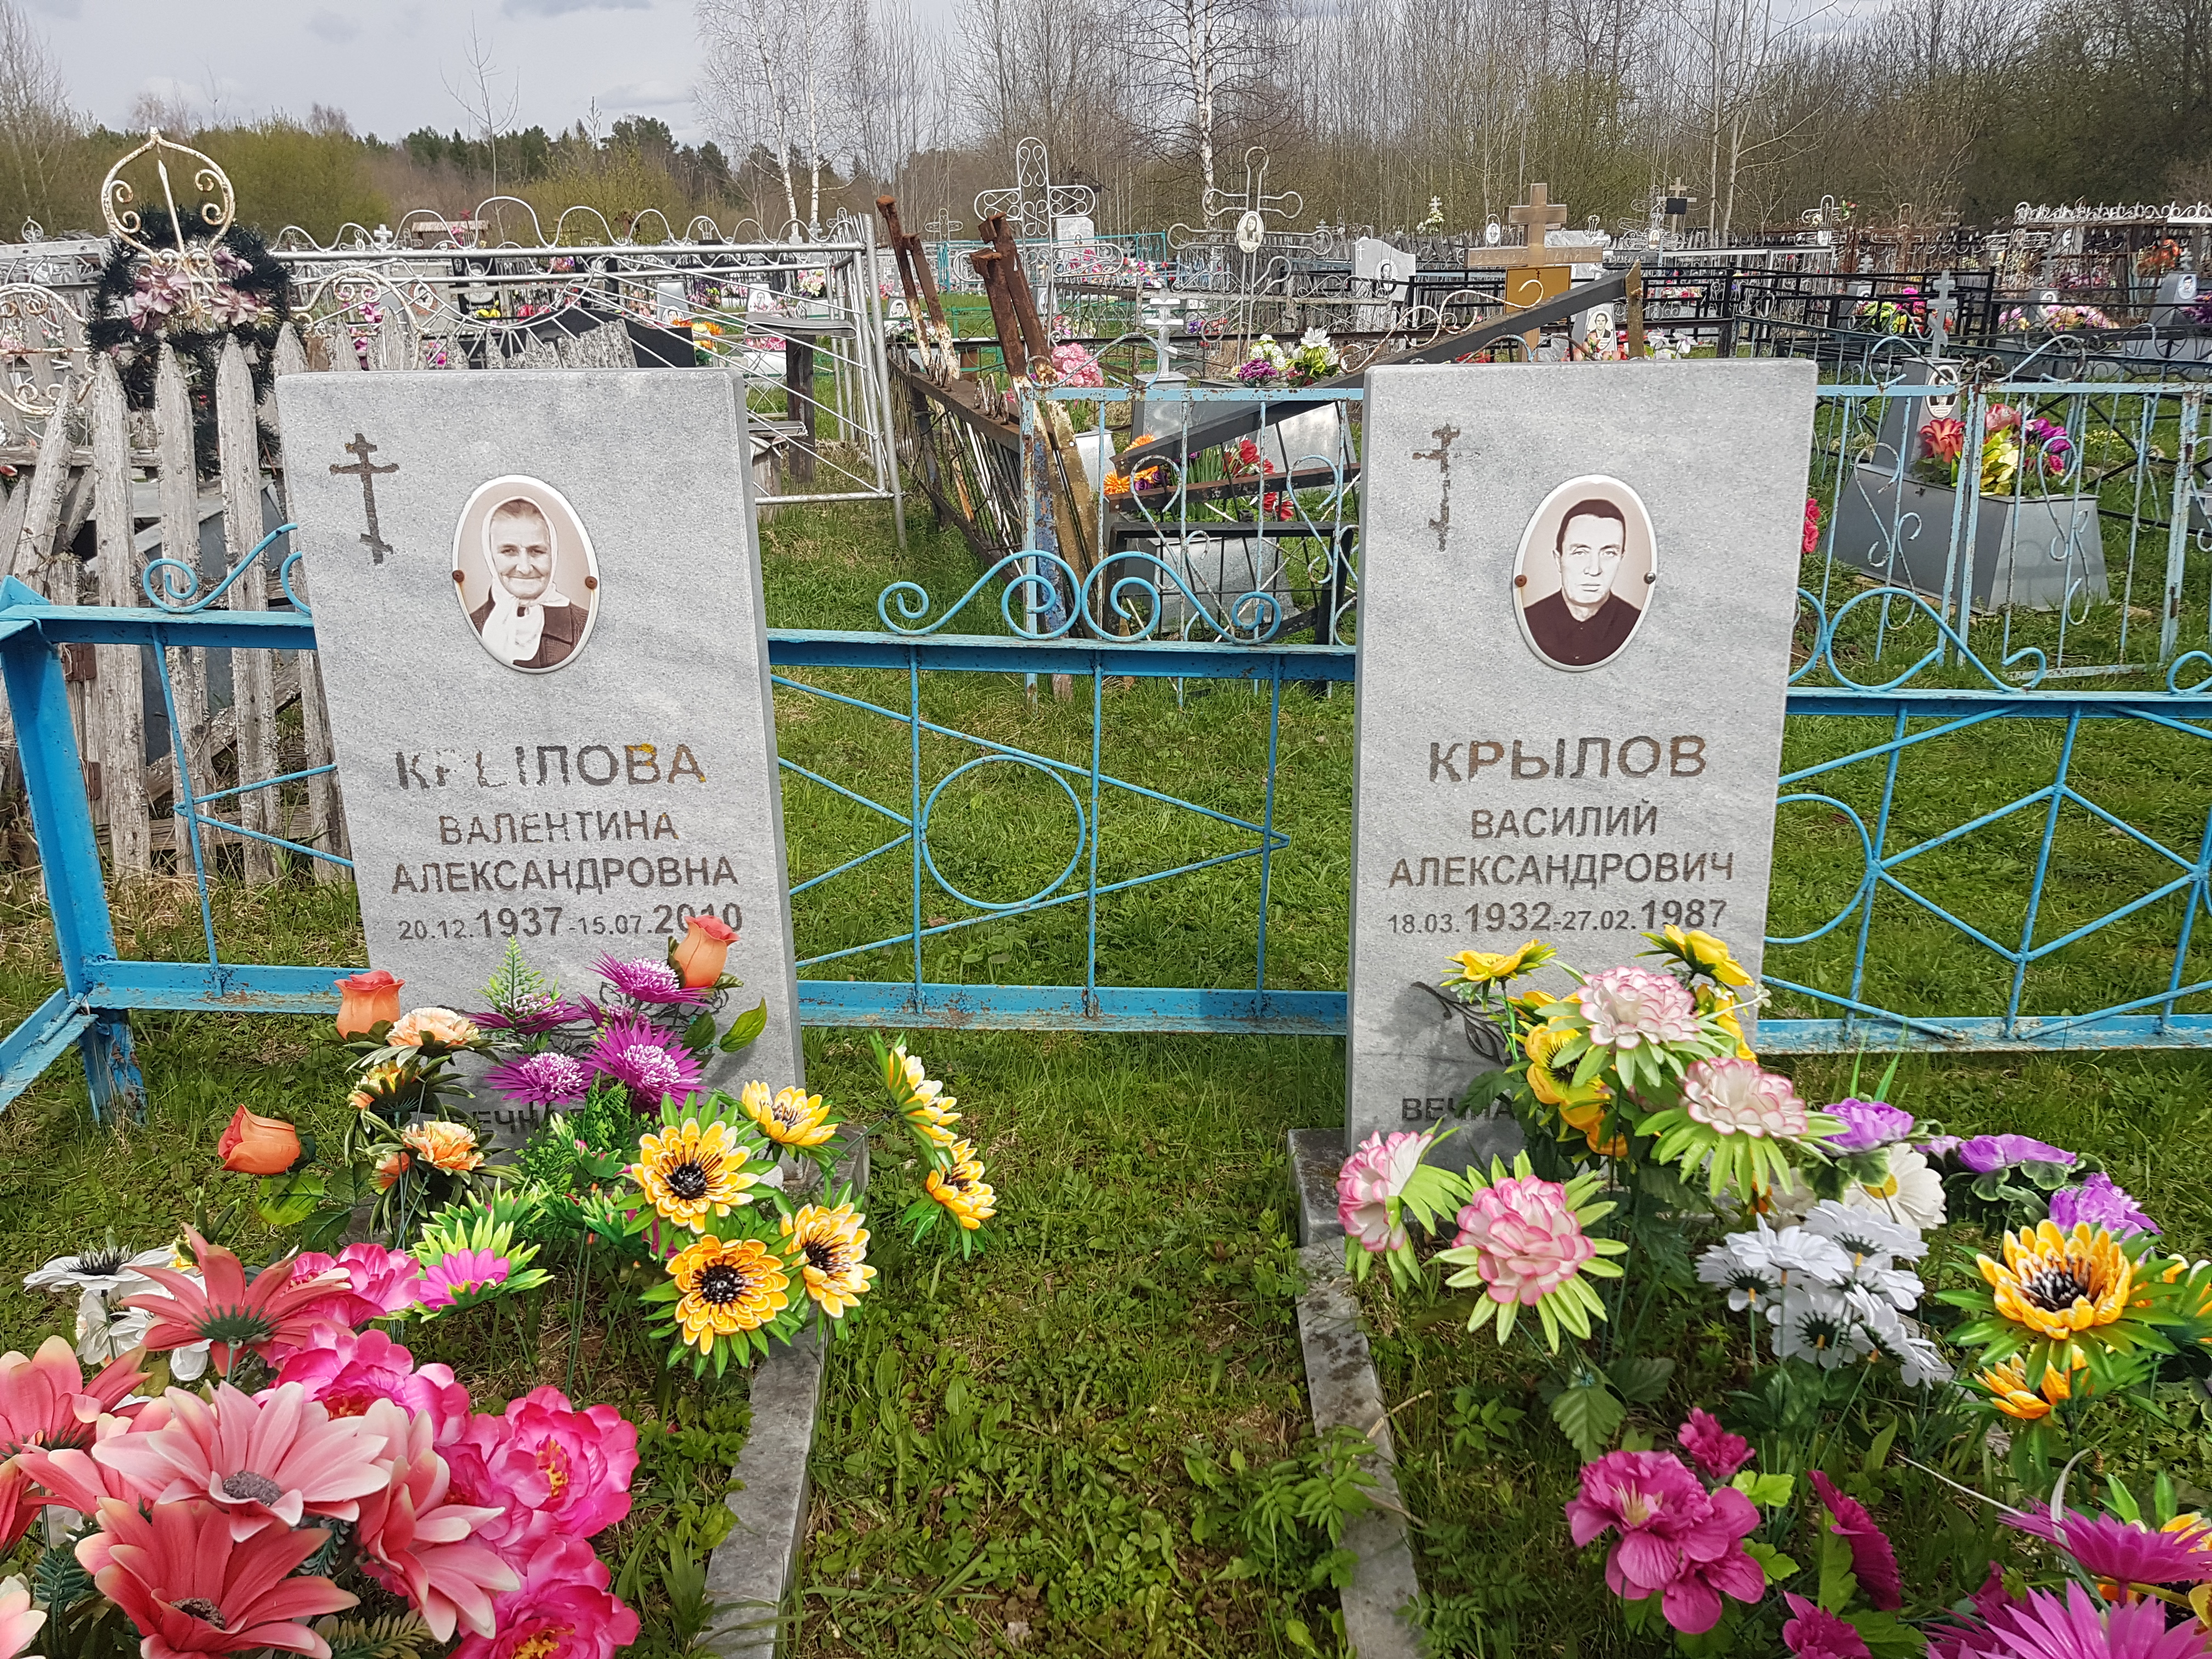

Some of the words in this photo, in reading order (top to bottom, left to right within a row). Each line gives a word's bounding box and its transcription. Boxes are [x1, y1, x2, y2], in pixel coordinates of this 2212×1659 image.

[1429, 736, 1707, 782] КРЫЛОВ
[439, 810, 679, 845] ВАЛЕНТИНА
[1471, 799, 1657, 839] ВАСИЛИЙ
[392, 856, 739, 895] АЛЕКСАНДРОВНА
[1389, 852, 1733, 890] АЛЕКСАНДРОВИЧ
